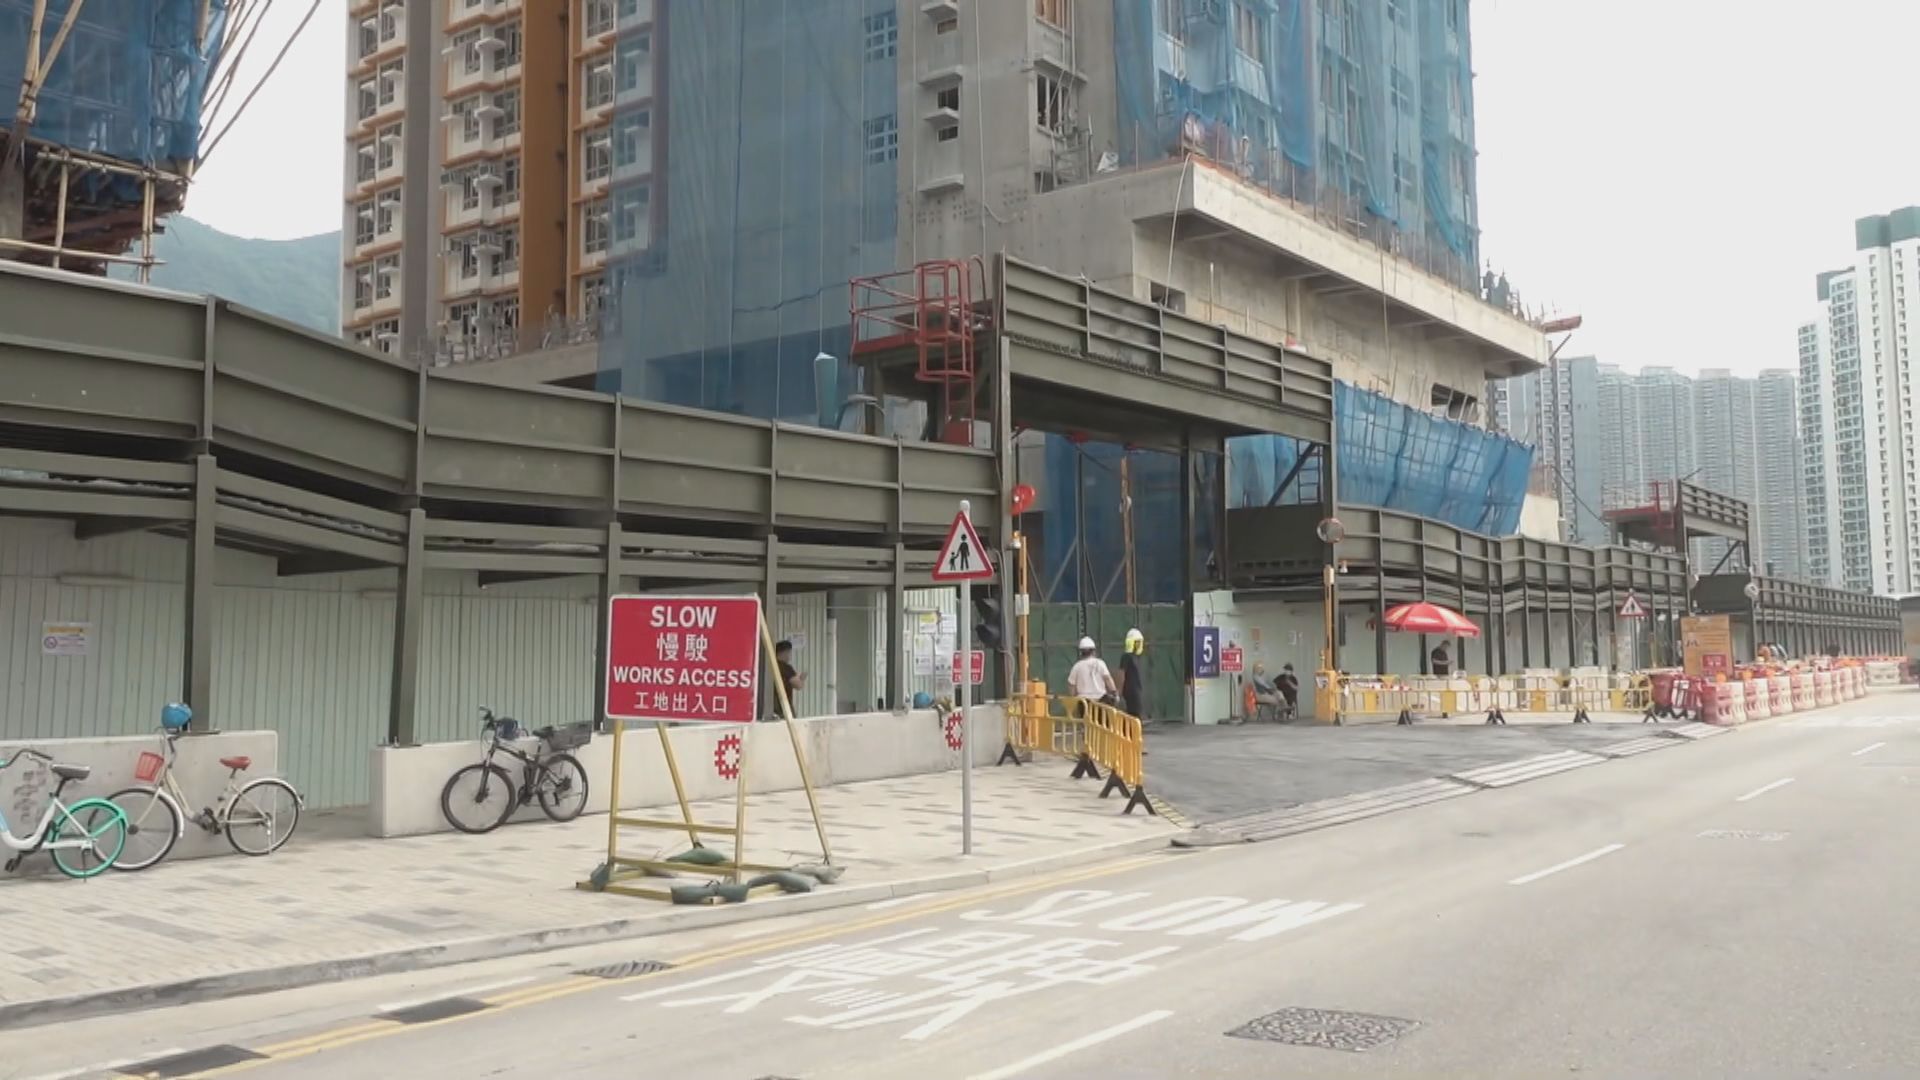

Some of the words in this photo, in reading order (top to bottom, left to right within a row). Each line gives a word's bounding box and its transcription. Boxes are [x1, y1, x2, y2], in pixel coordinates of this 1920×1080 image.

[650, 605, 717, 628] SLOW
[656, 632, 708, 662] 慢駛
[1203, 634, 1213, 664] 5
[613, 666, 675, 686] WORKS
[678, 668, 752, 688] ACCESS
[633, 691, 728, 714] 工地出入口
[958, 890, 1366, 942] SLOW
